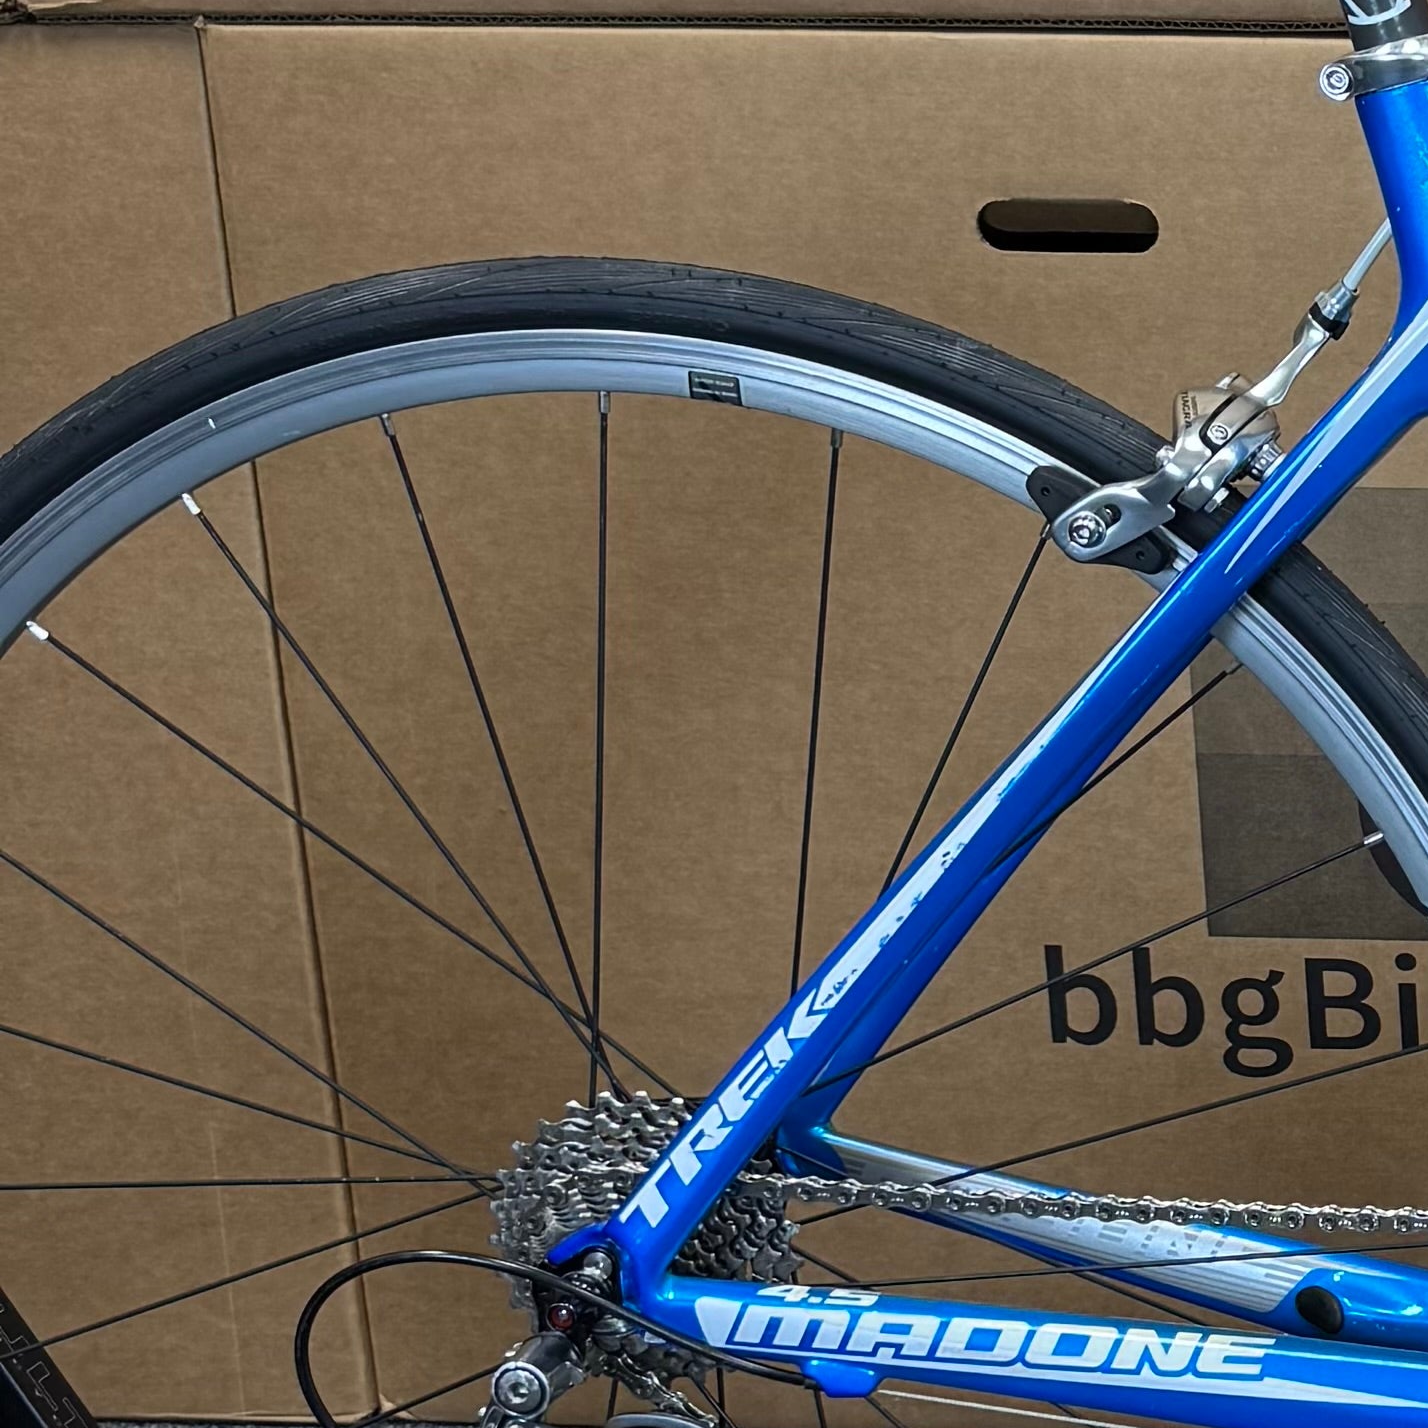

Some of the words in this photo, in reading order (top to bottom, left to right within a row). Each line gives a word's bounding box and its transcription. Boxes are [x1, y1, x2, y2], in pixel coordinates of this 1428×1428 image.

[619, 988, 829, 1228] TREK
[756, 1284, 881, 1307] 4.5
[734, 1301, 1277, 1377] MADONE
